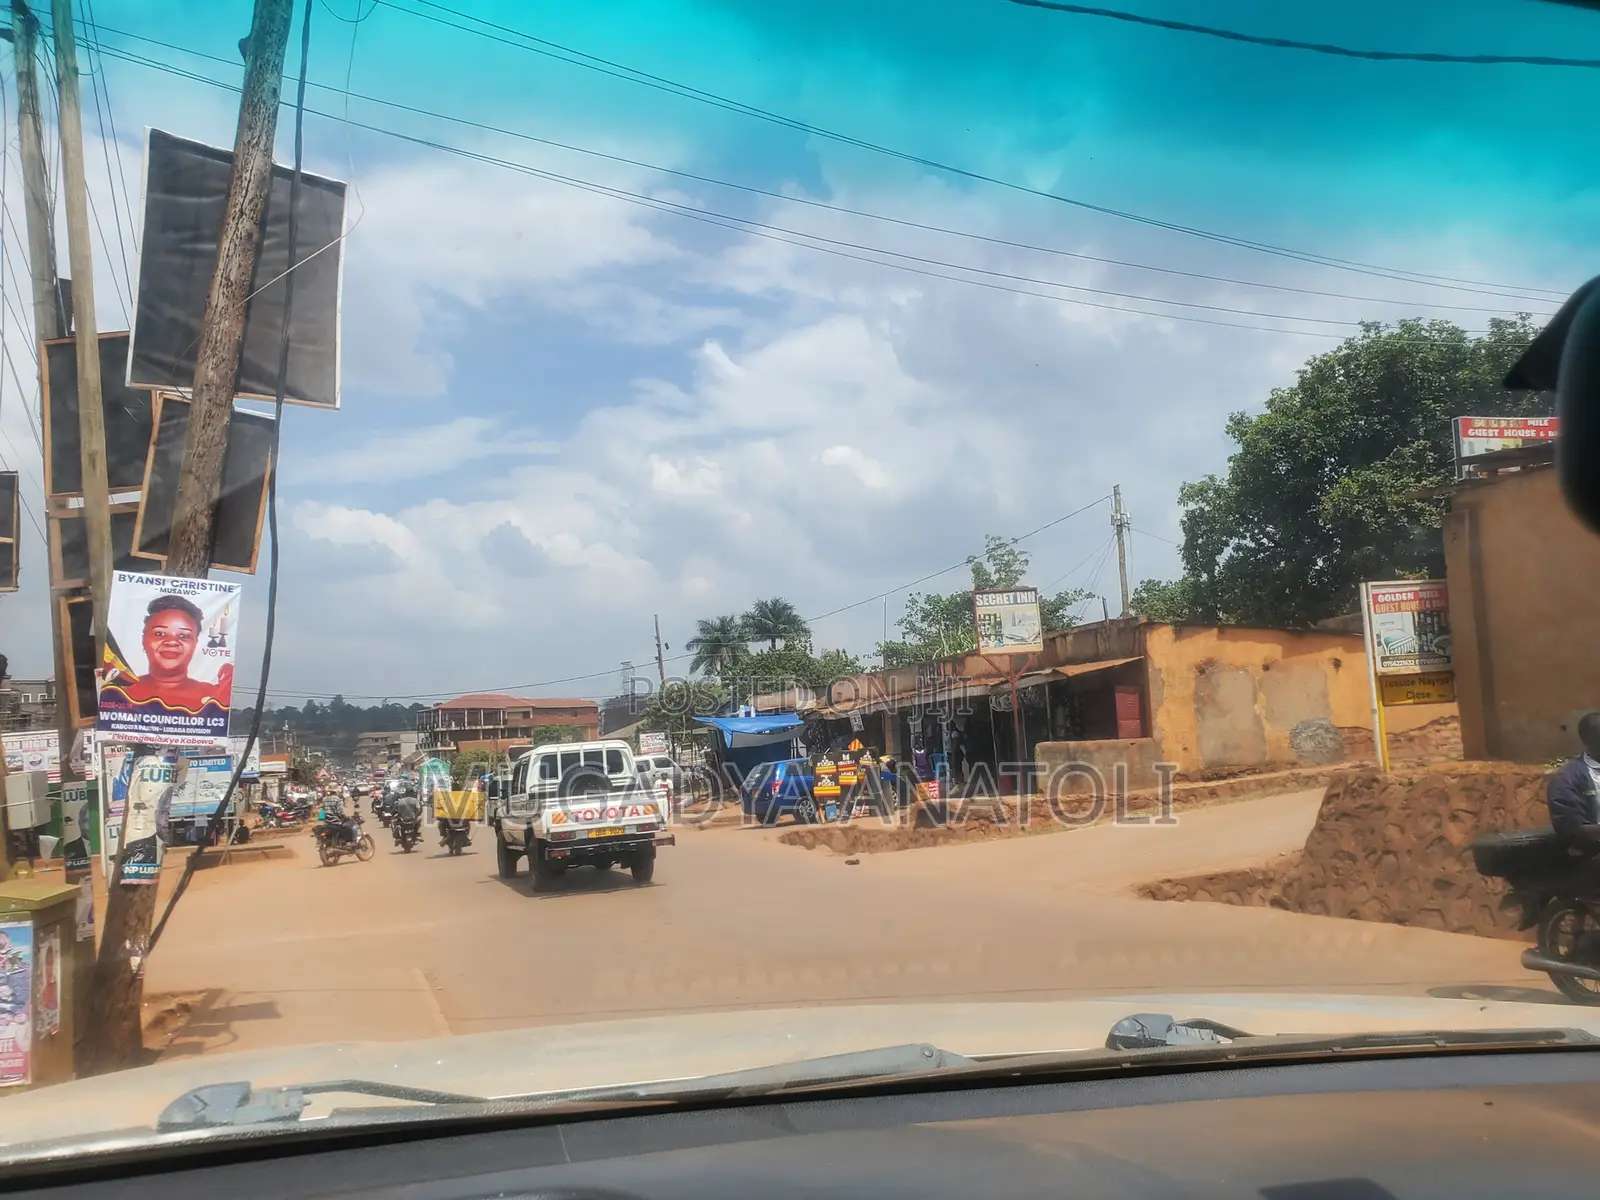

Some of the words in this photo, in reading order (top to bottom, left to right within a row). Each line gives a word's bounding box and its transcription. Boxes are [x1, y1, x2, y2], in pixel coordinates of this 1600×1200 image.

[1468, 428, 1500, 437] GUEST
[1503, 429, 1537, 437] HOUSE
[118, 574, 166, 587] BYANSI
[170, 580, 235, 593] CHRISTINE
[975, 592, 1014, 606] SECRET
[1016, 591, 1036, 603] INN
[1377, 591, 1415, 603] GOLDEN
[1375, 602, 1399, 614] GUEST
[1406, 691, 1431, 700] Close
[99, 711, 142, 723] WOMAN
[143, 714, 204, 726] COUNCILLOR
[207, 717, 225, 727] LC3
[199, 759, 226, 767] LIMITED
[571, 805, 641, 823] TOYOTA
